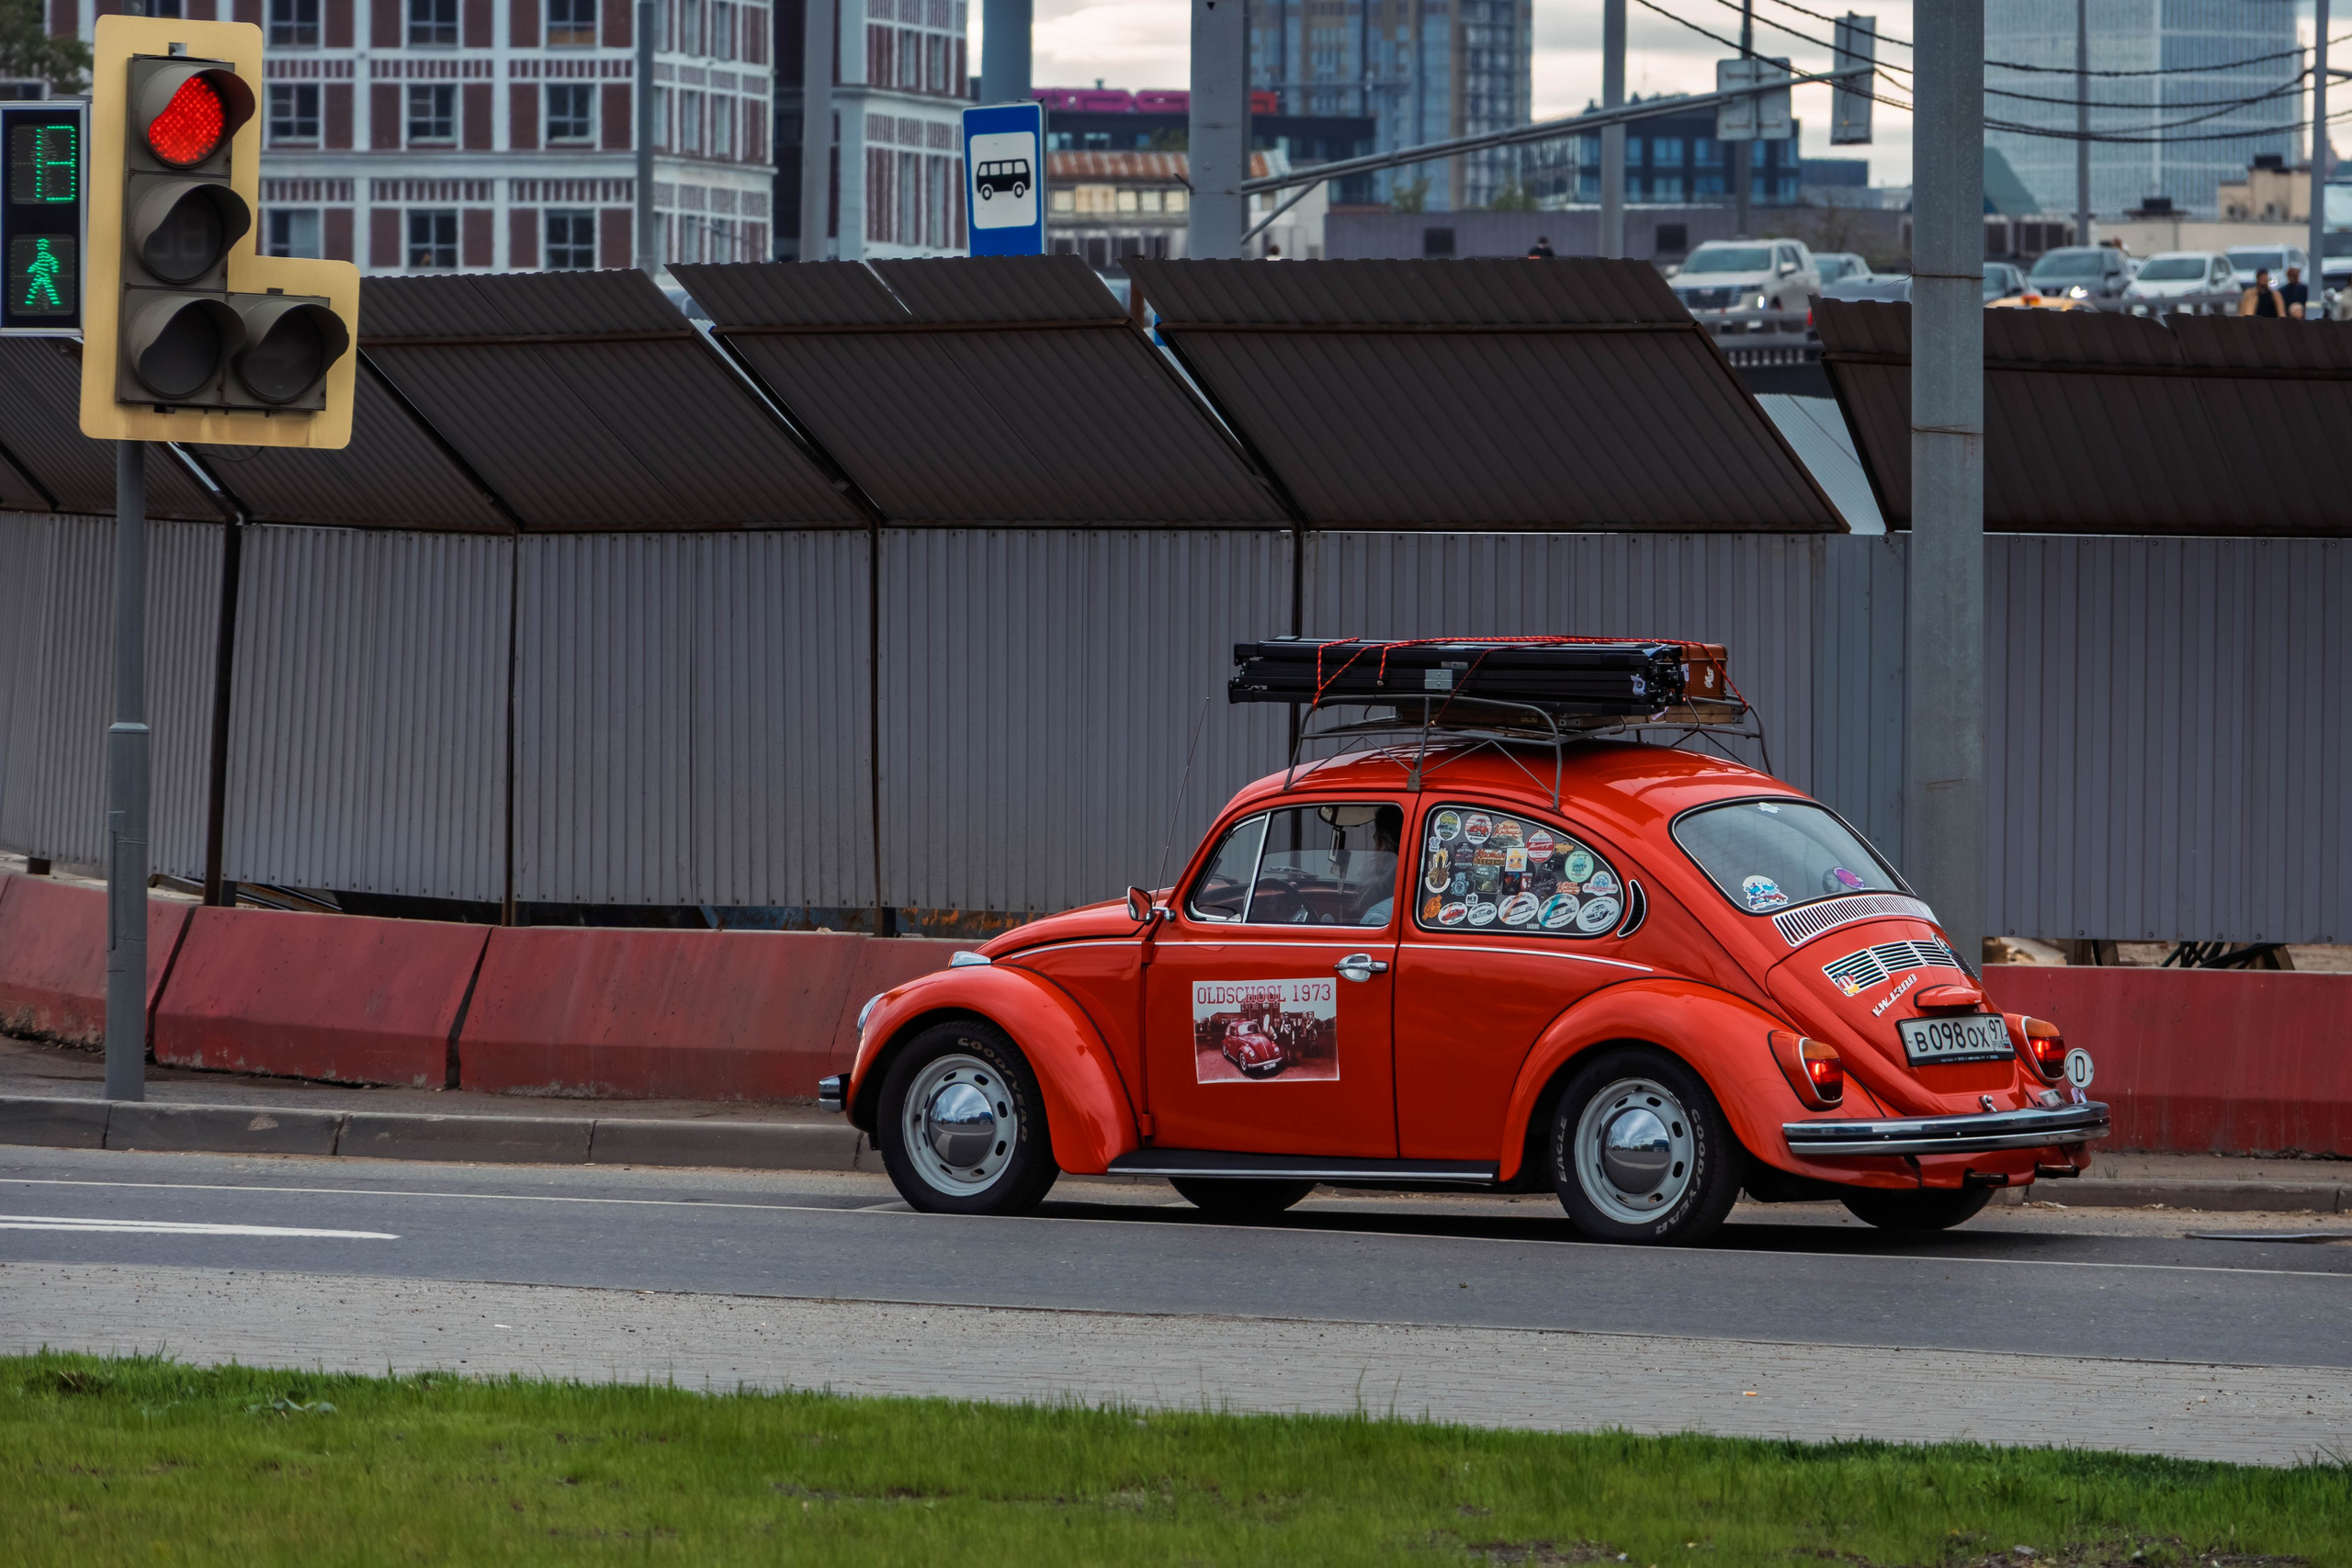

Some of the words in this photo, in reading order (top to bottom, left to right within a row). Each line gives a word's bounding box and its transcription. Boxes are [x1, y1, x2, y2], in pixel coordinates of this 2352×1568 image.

[1196, 985, 1286, 1005] OLDSCHOOL
[1293, 983, 1331, 1002] 1973
[1988, 1019, 2004, 1040] 97
[1993, 1040, 2004, 1048] RUS
[2075, 1055, 2086, 1082] D
[956, 1036, 1029, 1144] GOODYEAR
[1555, 1116, 1568, 1183] EAGLE
[1655, 1107, 1707, 1235] GOODYEAR
